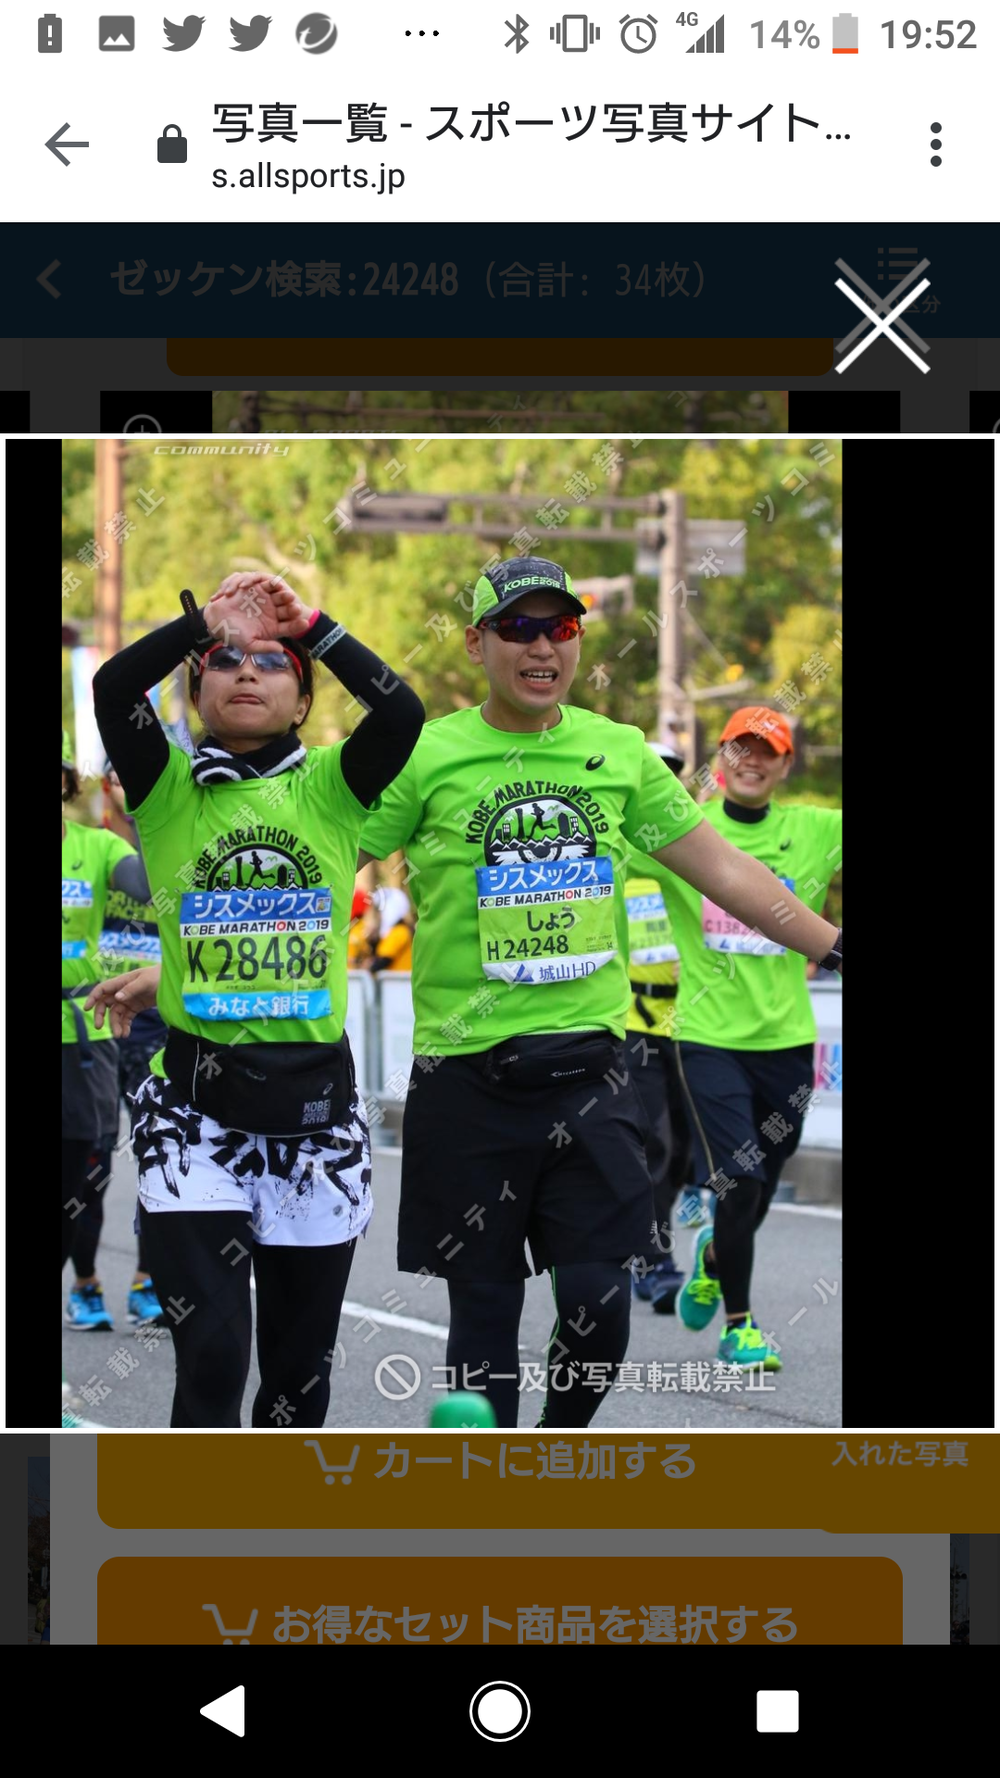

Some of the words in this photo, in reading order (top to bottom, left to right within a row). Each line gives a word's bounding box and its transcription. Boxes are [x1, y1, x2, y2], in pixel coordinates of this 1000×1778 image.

[676, 12, 698, 26] 4G
[751, 19, 820, 49] 14%
[881, 19, 977, 49] 19:52
[213, 102, 387, 143] 写真一覧
[212, 162, 405, 195] s.allsports.jp
[504, 577, 539, 592] KOBE
[465, 800, 496, 844] KOBE
[494, 780, 583, 808] MARATHON
[576, 792, 609, 834] 2019
[193, 849, 217, 889] KOBE
[217, 826, 299, 856] MARATHON
[298, 845, 323, 885] 2019
[489, 861, 596, 892] シスメックス
[195, 892, 316, 919] シスメックス
[480, 896, 511, 908] KOBE
[515, 889, 581, 905] MARATHON
[584, 885, 611, 898] 2019
[184, 925, 216, 936] KOBE
[219, 920, 296, 935] MARATHON
[298, 919, 329, 931] 2019
[527, 907, 575, 932] しょう
[187, 934, 327, 983] K28486
[487, 935, 569, 960] H24248
[539, 961, 596, 981] 城山HD
[208, 994, 309, 1017] みなと銀行
[304, 1100, 330, 1112] KOBE
[374, 1441, 695, 1480] カートに追加する
[832, 1441, 968, 1467] 入れた写真
[274, 1604, 797, 1644] お得なセット商品を選択する
